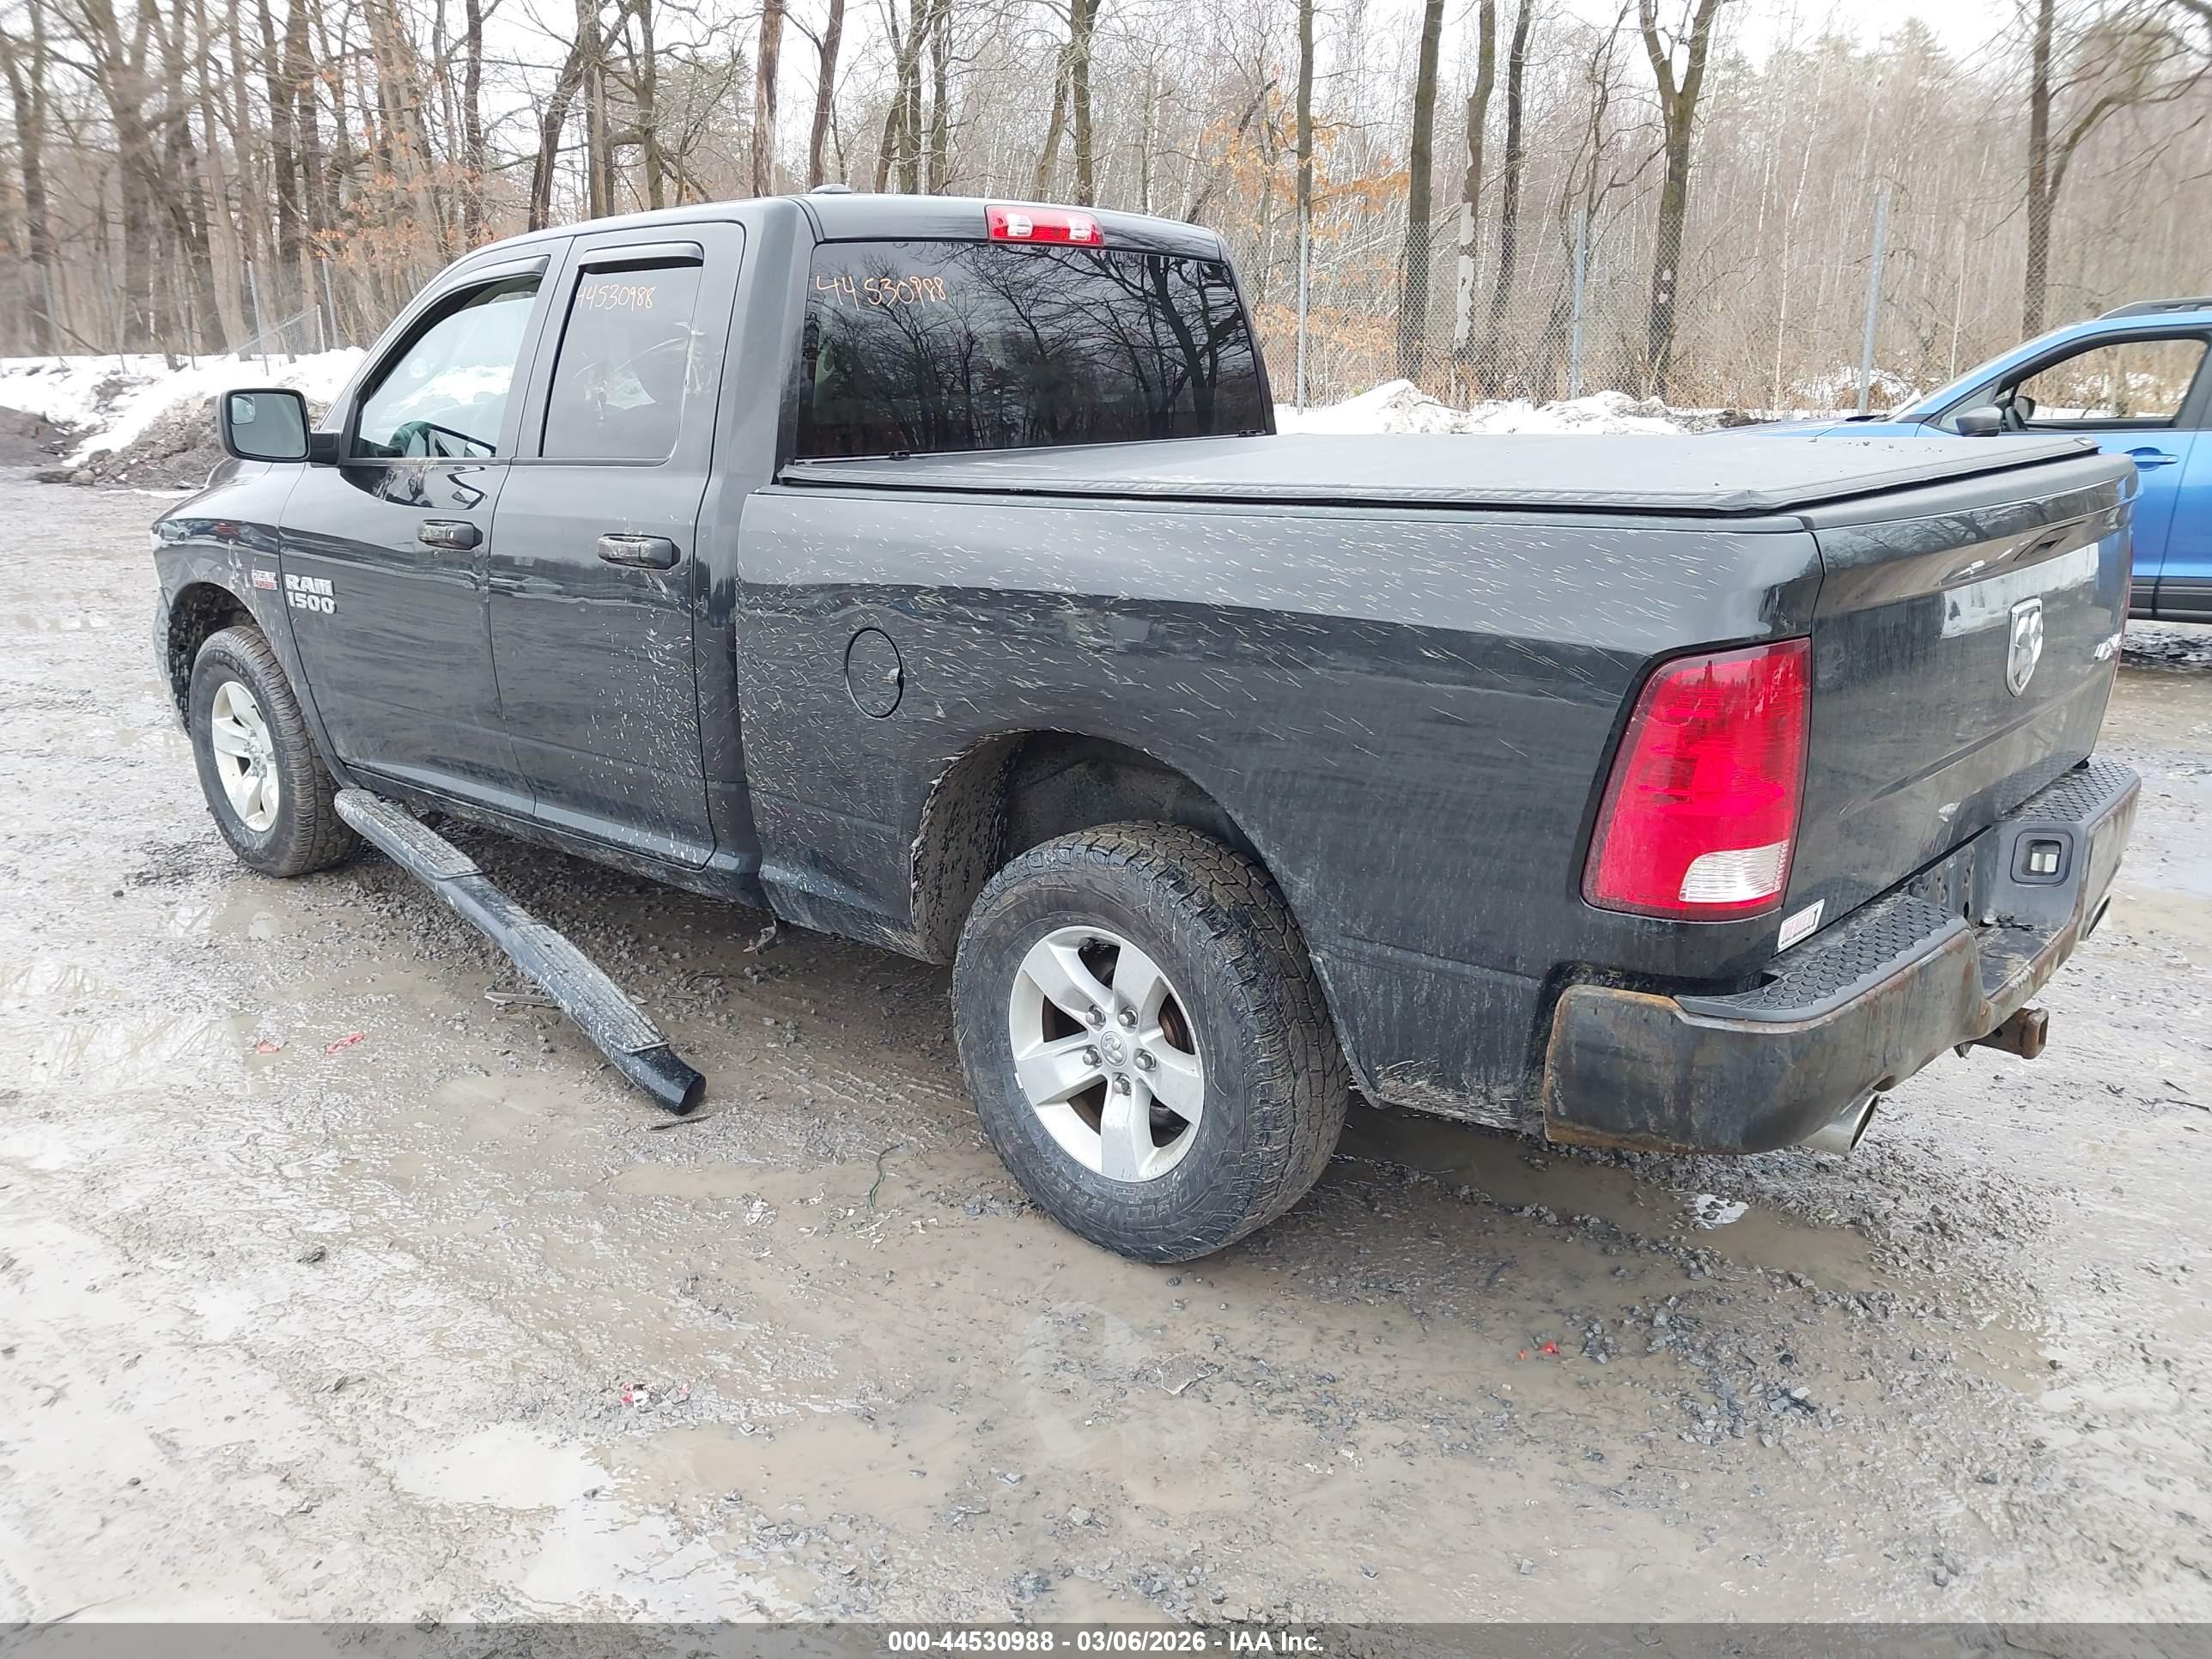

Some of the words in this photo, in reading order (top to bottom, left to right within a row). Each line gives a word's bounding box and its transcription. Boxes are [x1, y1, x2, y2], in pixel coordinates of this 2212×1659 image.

[576, 283, 657, 311] 44530988
[284, 574, 334, 597] RAM
[287, 591, 336, 615] 1500
